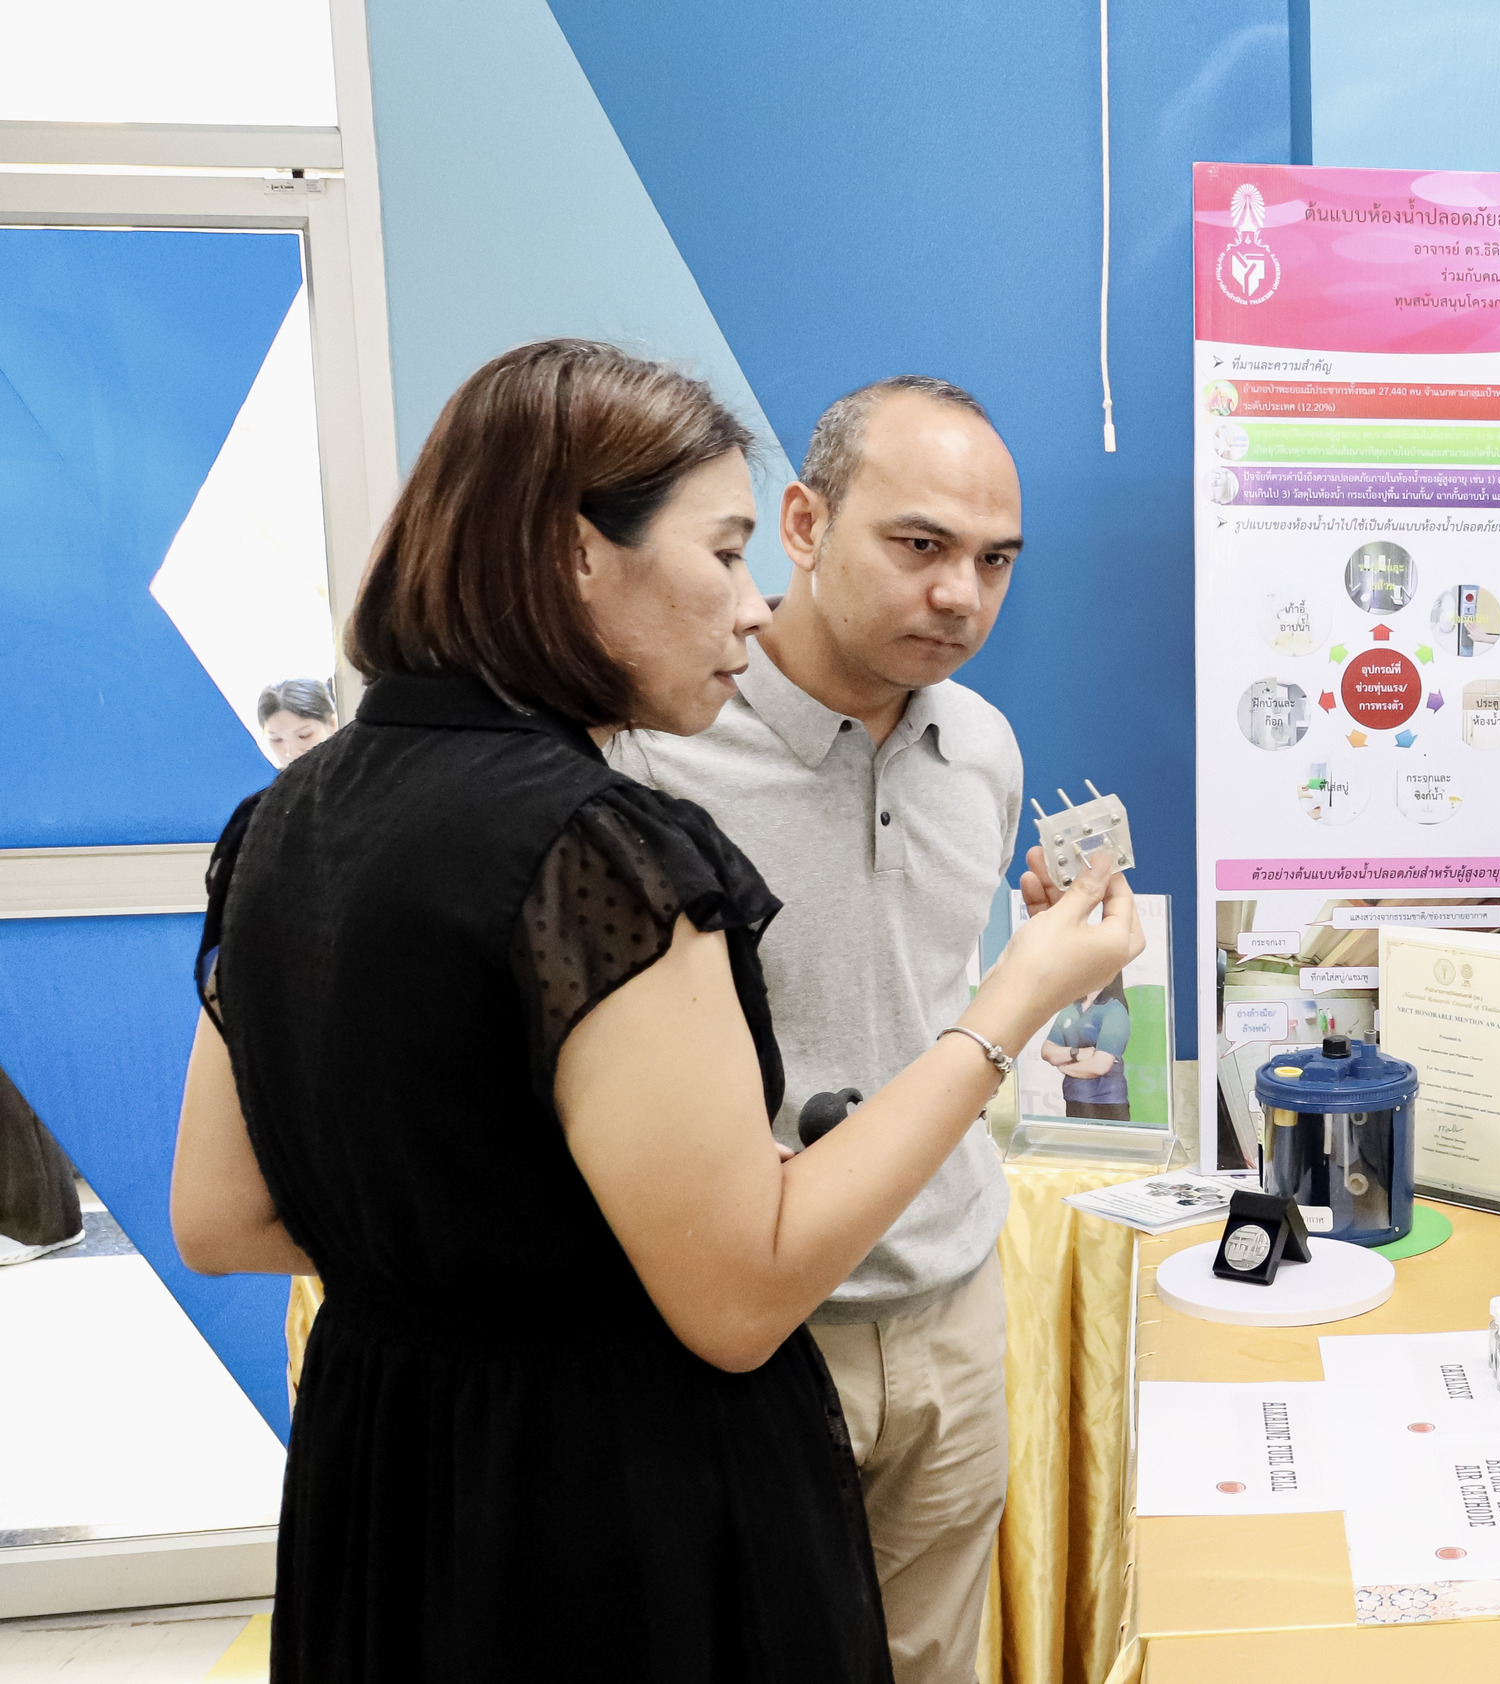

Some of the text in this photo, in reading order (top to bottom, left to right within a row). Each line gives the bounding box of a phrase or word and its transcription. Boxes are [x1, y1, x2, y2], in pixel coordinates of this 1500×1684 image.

[1414, 239, 1460, 256] อาจารย์
[1232, 357, 1333, 375] ที่มาและความสำคัญ
[1285, 599, 1306, 614] เก้าอี้
[1280, 617, 1310, 632] อาบน้ำ
[1361, 663, 1402, 678] อุปกรณ์ที่
[1355, 681, 1408, 696] ช่วยทุ่นแรง/
[1359, 699, 1404, 712] การทรงตัว
[1475, 697, 1499, 712] ประตู
[1252, 863, 1500, 883] ตัวอย่างต้นแบบห้องน้ำปลอดภัยสำหรับผู้สูงอายุ
[1415, 1008, 1453, 1021] HONORABLE
[1454, 1015, 1484, 1027] MENTION
[1440, 1364, 1474, 1400] CATALYST
[1262, 1401, 1298, 1492] ALKALINE FUEL CELL
[1455, 1464, 1497, 1528] AIR CATHODE
